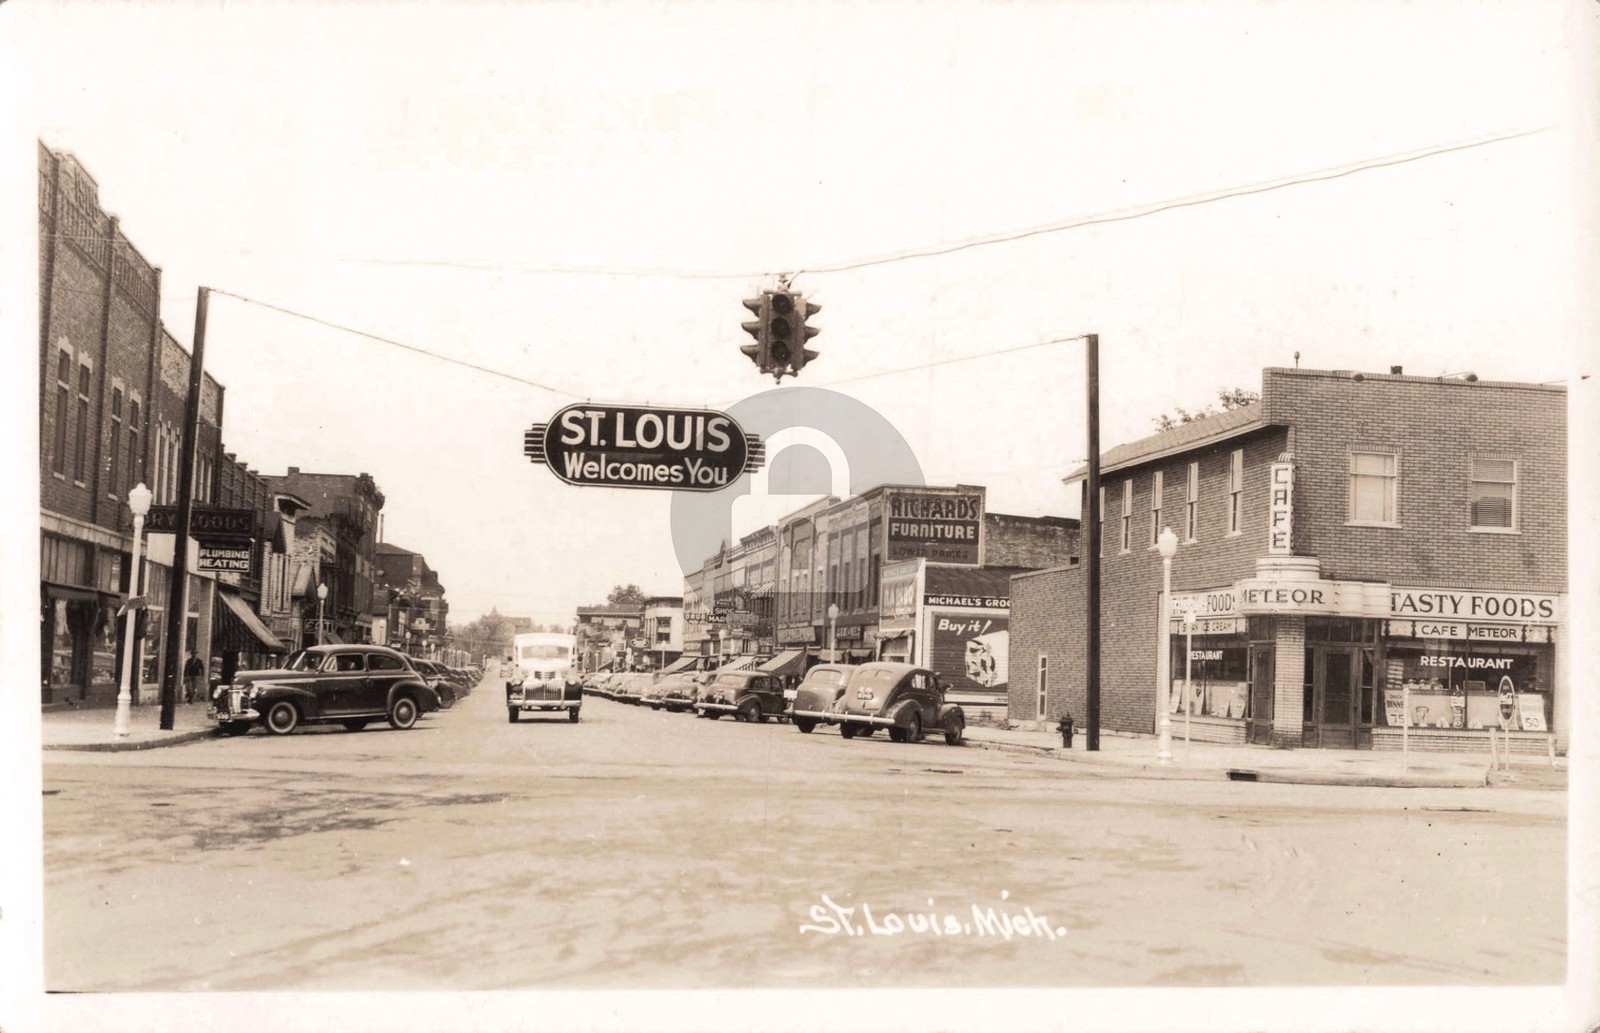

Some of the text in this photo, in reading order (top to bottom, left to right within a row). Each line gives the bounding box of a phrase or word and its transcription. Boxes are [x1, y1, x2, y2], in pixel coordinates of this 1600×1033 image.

[561, 410, 731, 452] ST. LOUIS
[563, 452, 728, 485] Welcomes You
[1273, 467, 1289, 549] CAFE
[200, 549, 249, 559] PLUMBING
[931, 549, 969, 560] PRICES
[200, 559, 249, 569] HEATING
[928, 597, 981, 607] MICHAEL'S
[1471, 596, 1553, 618] FOODS
[937, 618, 993, 637] Buy it!
[1421, 625, 1517, 639] CAFE METEOR
[1420, 655, 1514, 670] RESTAURANT
